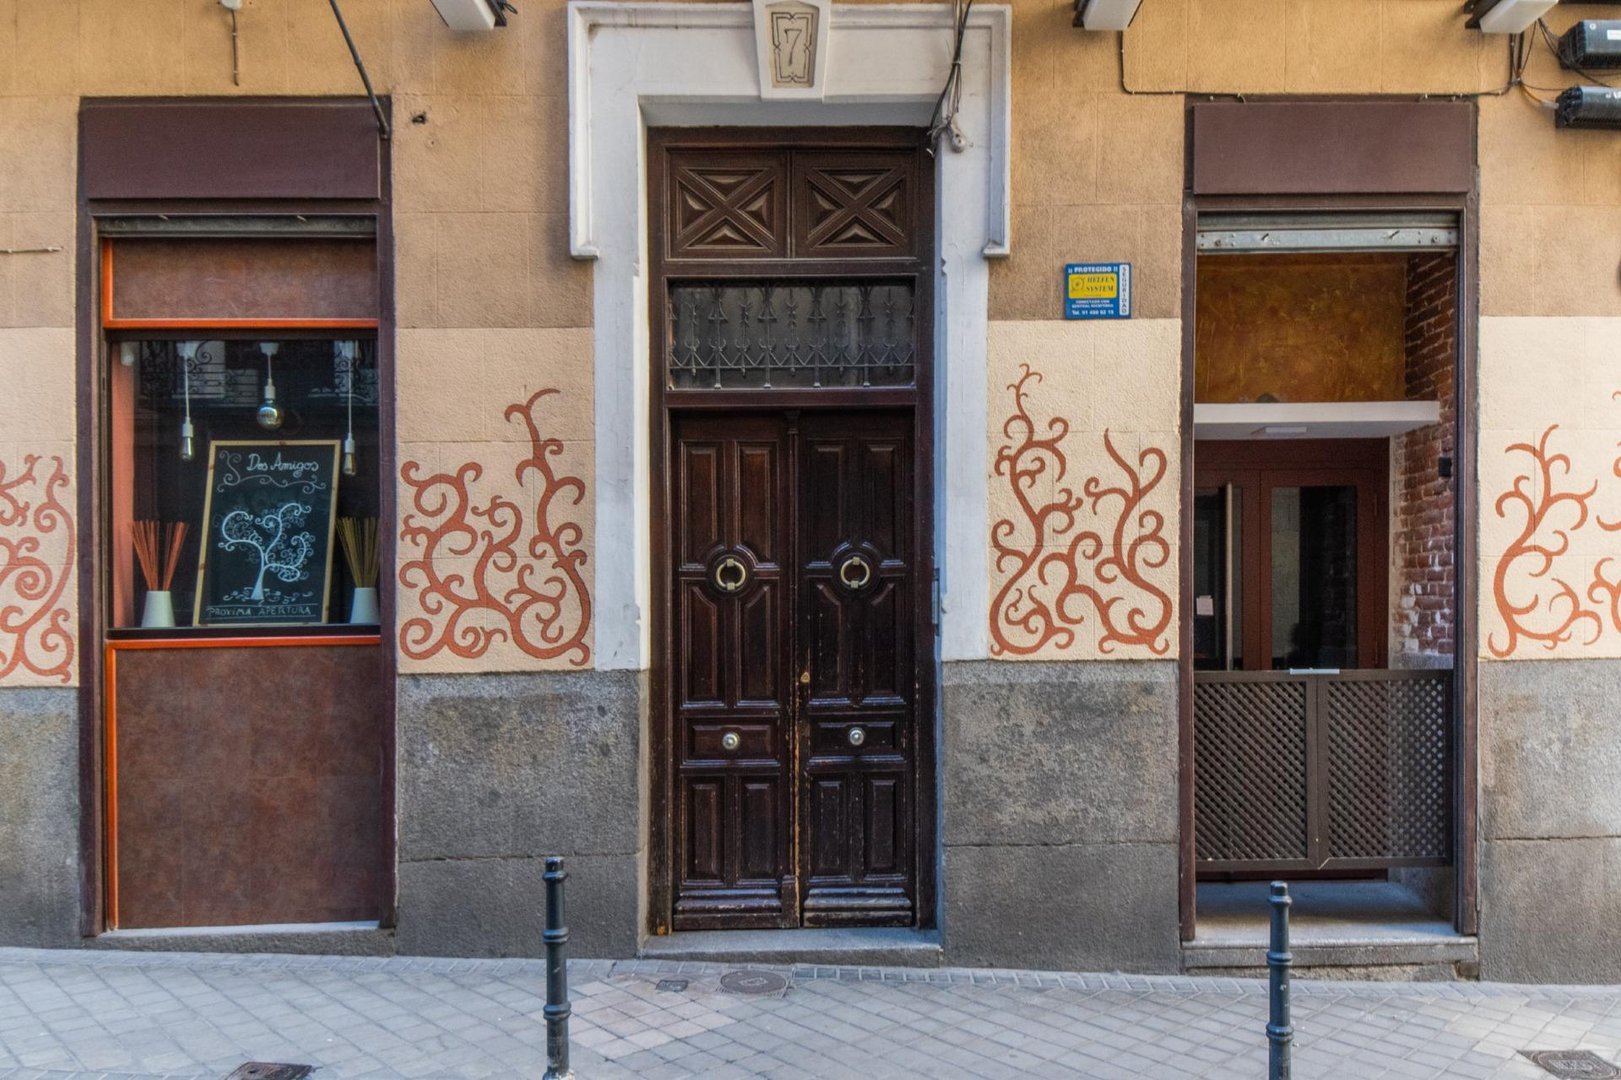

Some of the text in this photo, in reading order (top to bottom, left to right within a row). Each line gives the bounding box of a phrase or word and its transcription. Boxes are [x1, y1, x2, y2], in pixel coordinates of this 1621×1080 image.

[784, 28, 802, 66] 7
[246, 451, 319, 478] Dos Amigos
[259, 605, 312, 616] APERTURA
